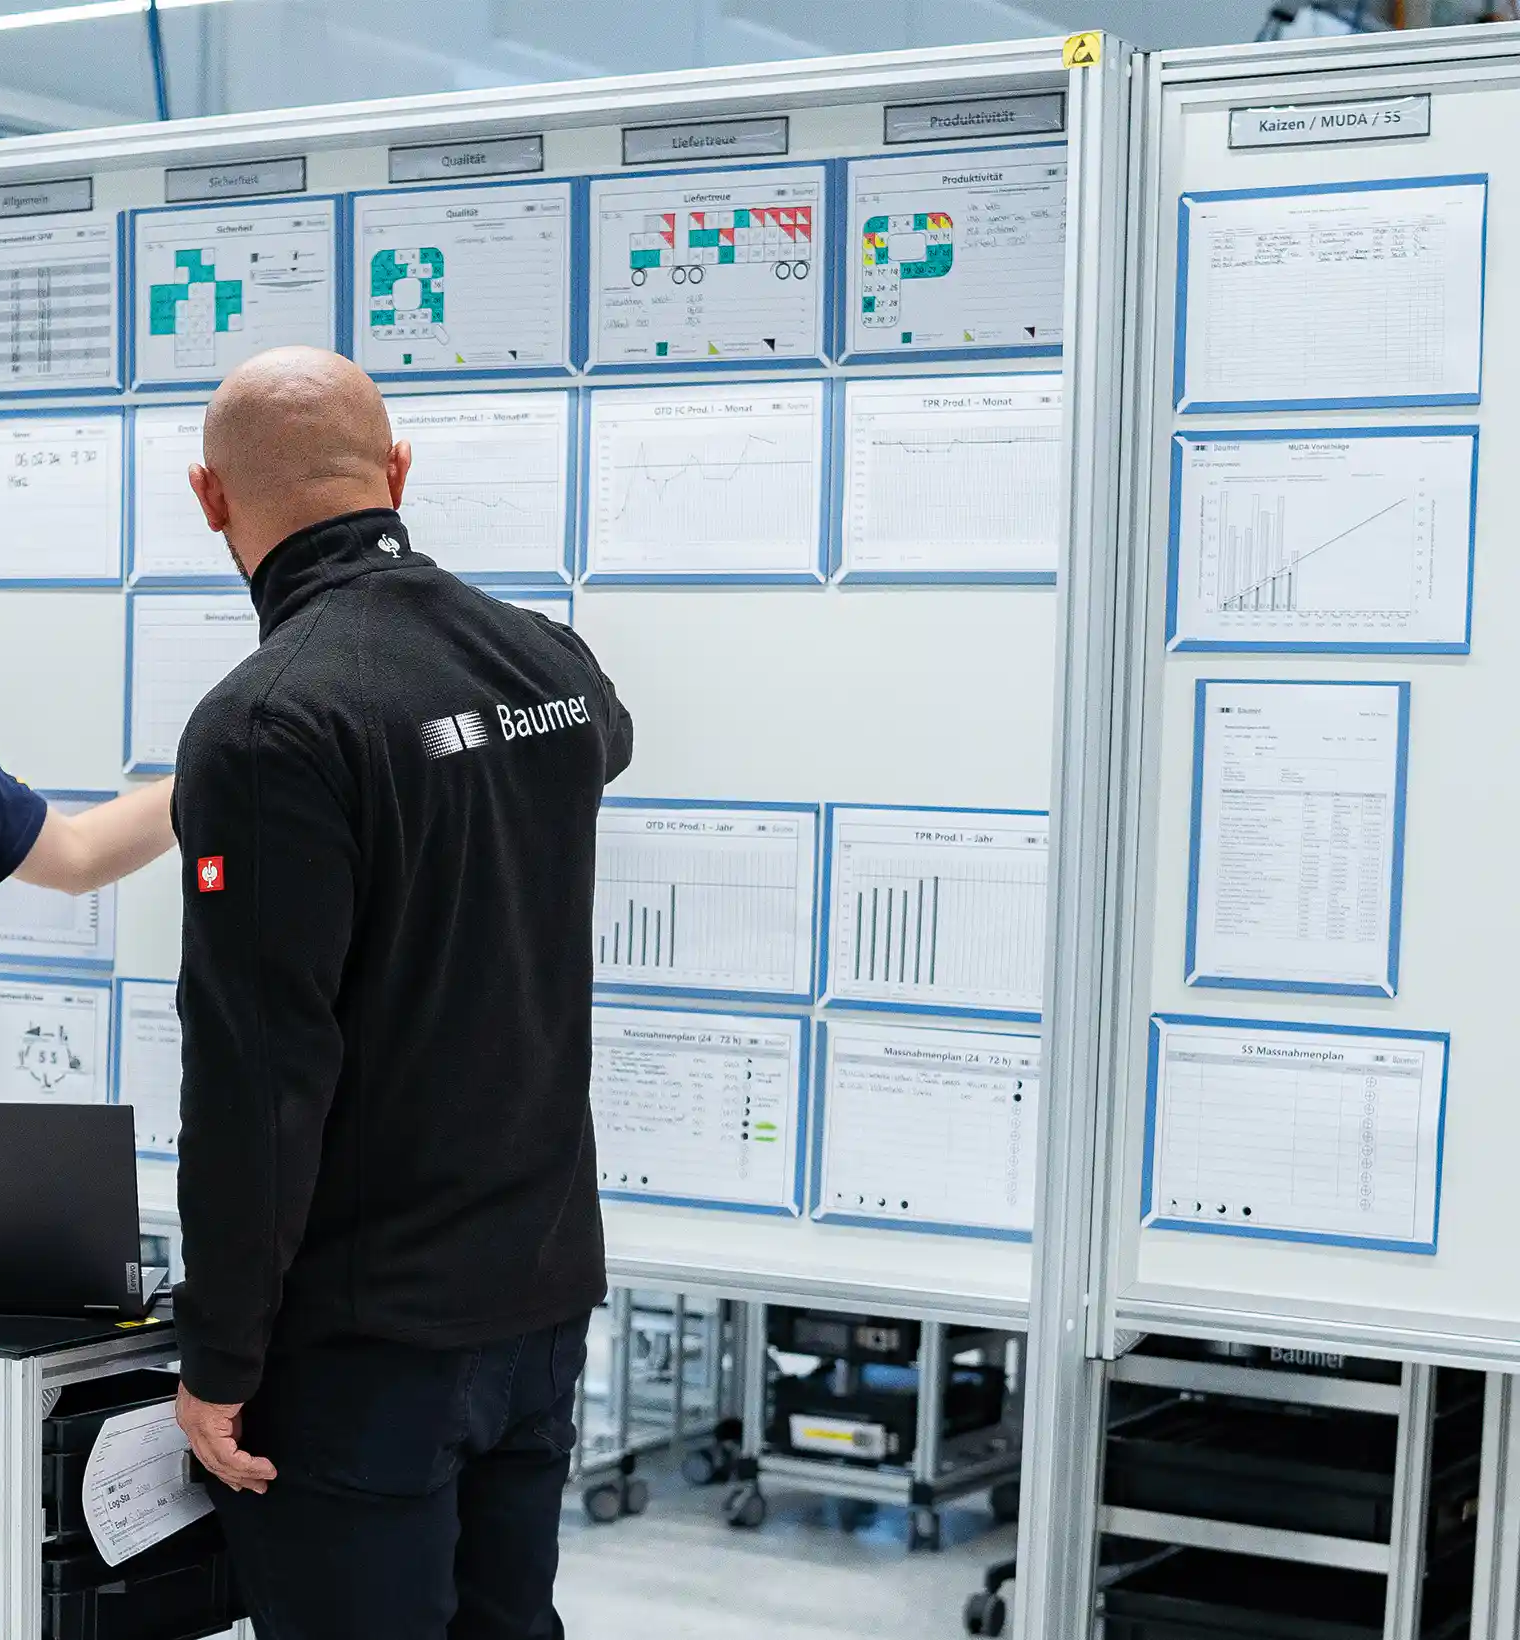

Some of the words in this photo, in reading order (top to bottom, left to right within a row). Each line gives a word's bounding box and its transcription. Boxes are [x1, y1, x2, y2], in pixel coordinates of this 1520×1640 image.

[930, 109, 1017, 128] Produktivität
[1259, 119, 1305, 132] Kaizen
[1321, 113, 1367, 128] MUDA
[1384, 110, 1401, 124] 5S
[672, 135, 737, 149] Liefertreue
[441, 153, 487, 168] Qualität
[942, 172, 1004, 184] Produktivität
[683, 193, 731, 204] Liefertreue
[446, 208, 479, 219] Qualität
[983, 397, 1012, 406] Monat
[725, 404, 753, 414] Monat
[1288, 443, 1309, 451] MUDA
[496, 696, 591, 740] Baumer
[646, 821, 664, 830] OTD
[715, 824, 734, 832] Jahr
[974, 834, 993, 843] Jahr
[623, 1029, 696, 1044] Massnahmenplan
[720, 1036, 730, 1045] 72
[884, 1047, 962, 1062] Massnahmenplan
[989, 1055, 1000, 1065] 72
[1002, 1056, 1012, 1067] h)
[1256, 1046, 1344, 1061] Massnahmenplan
[1270, 1346, 1345, 1369] Baumer
